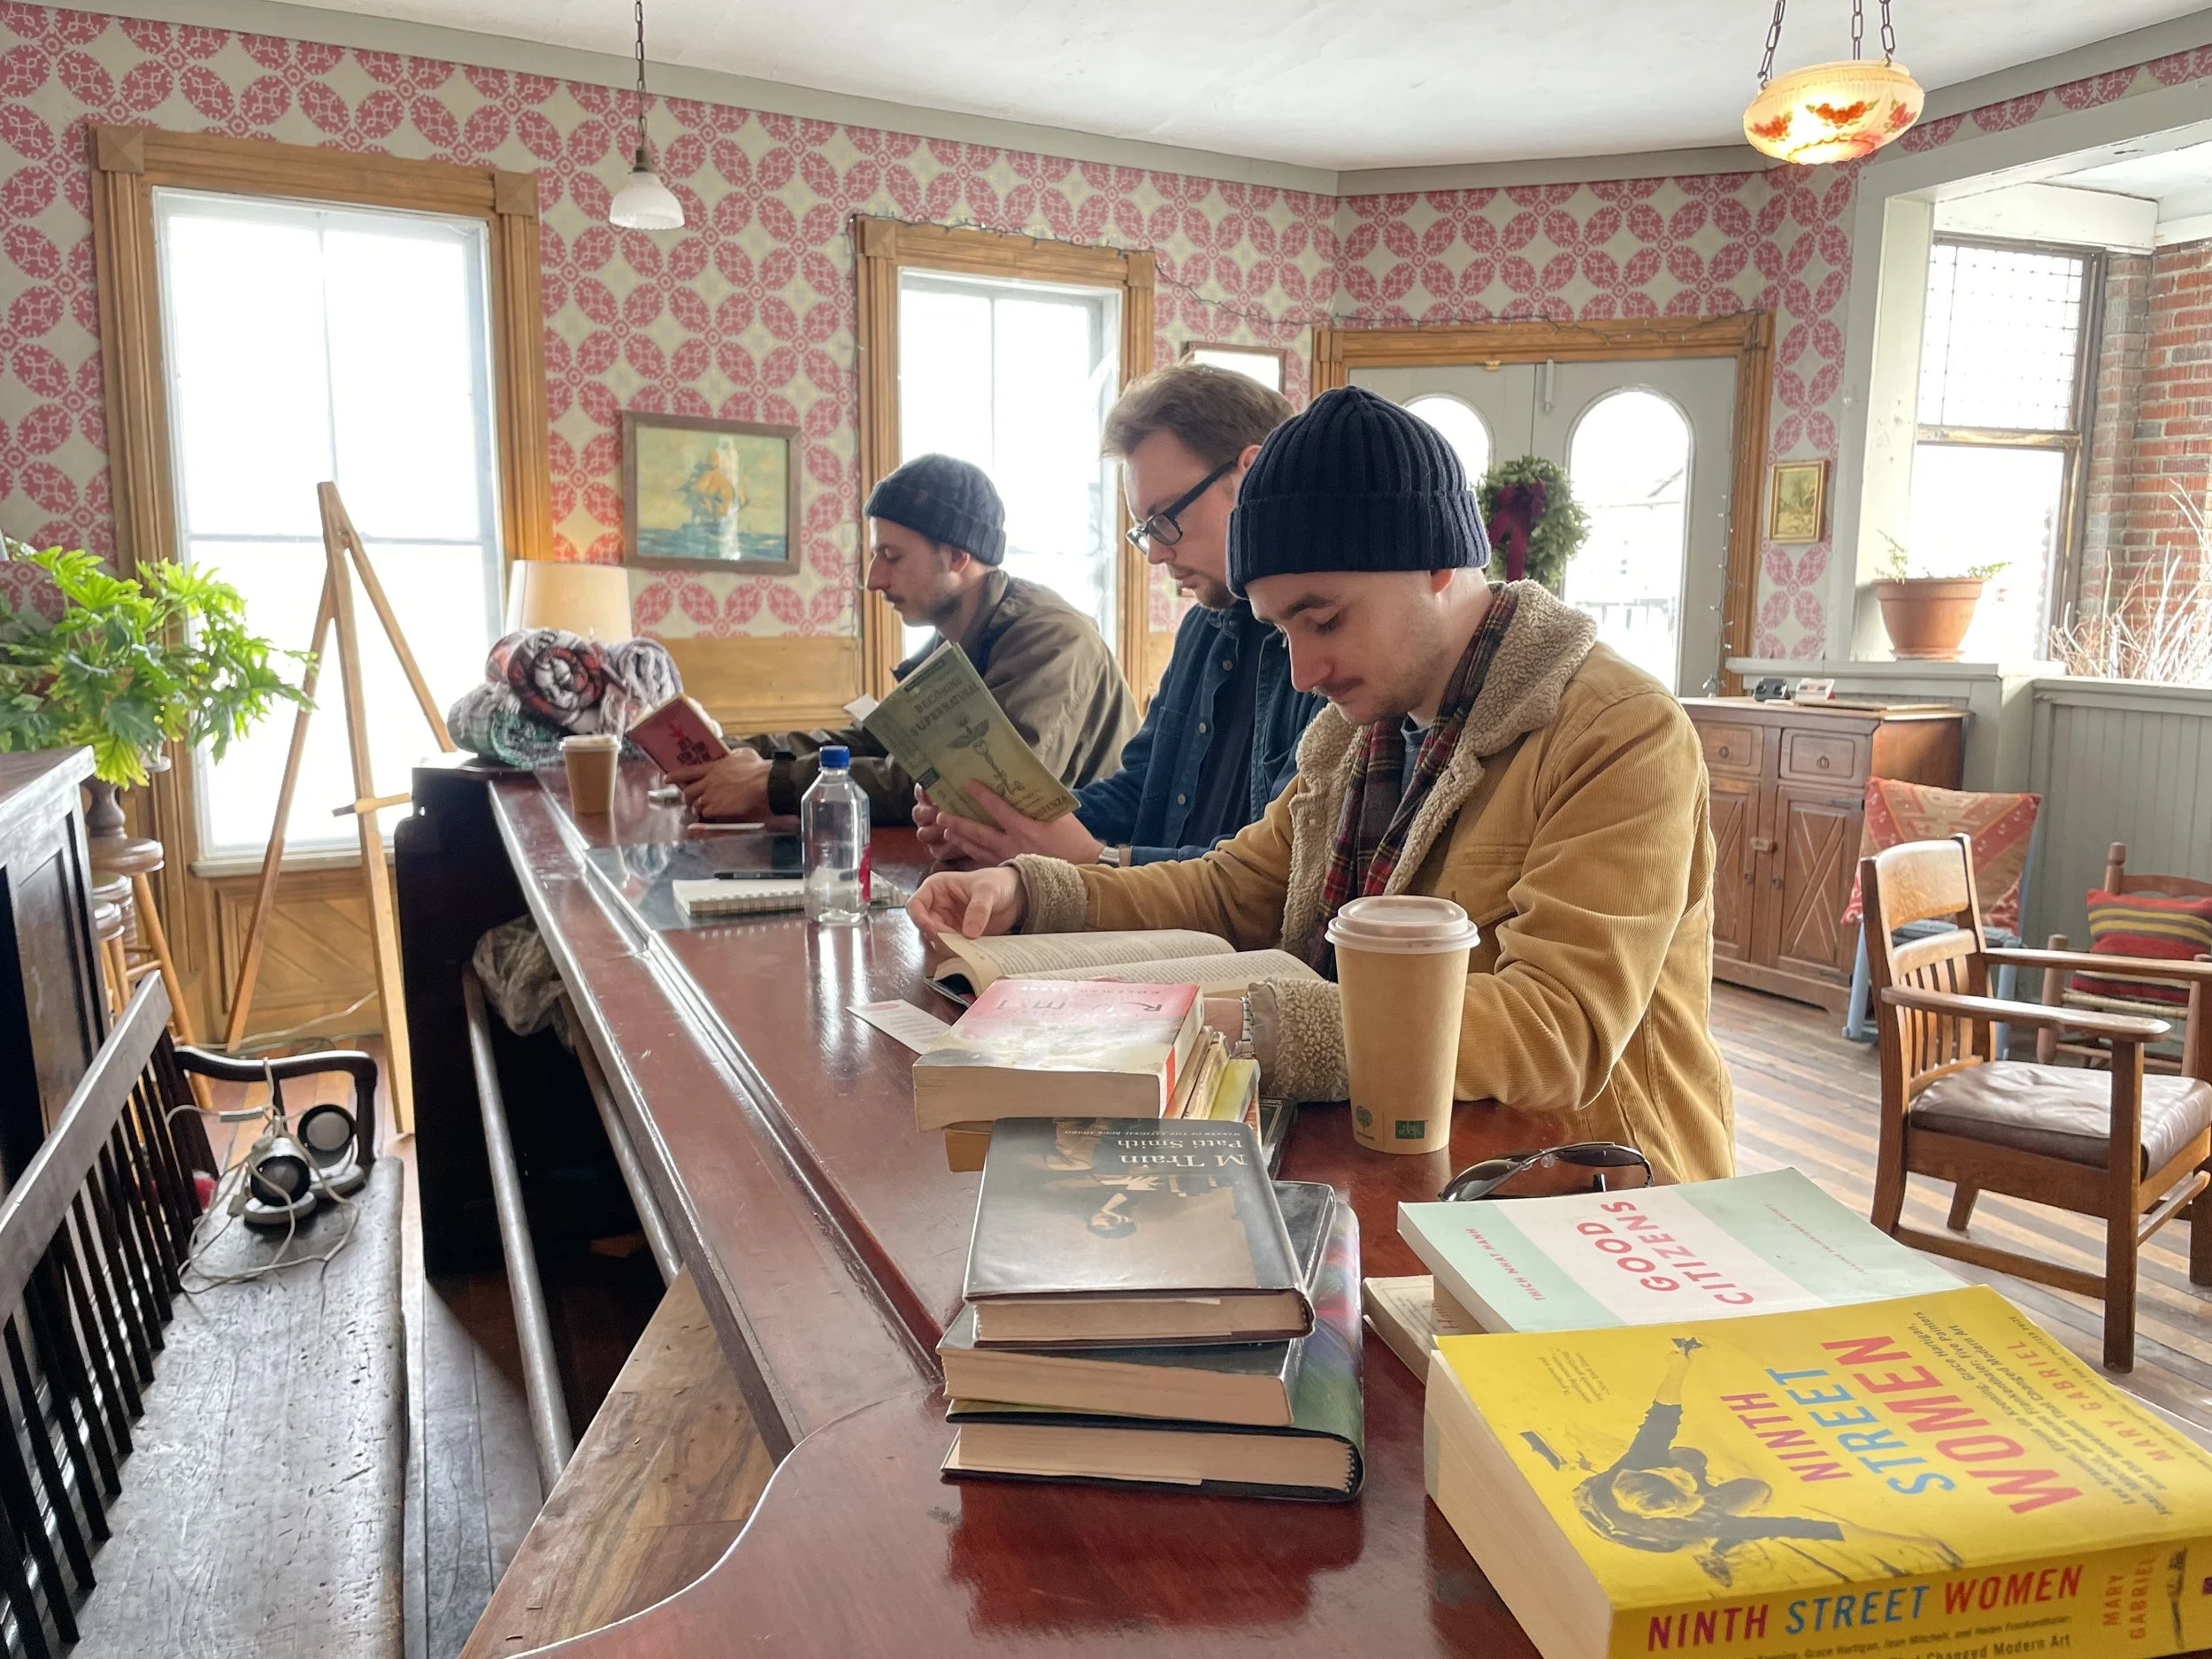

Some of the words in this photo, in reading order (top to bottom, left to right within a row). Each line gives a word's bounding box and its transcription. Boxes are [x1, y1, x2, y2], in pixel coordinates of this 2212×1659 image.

[910, 681, 980, 737] SUPERNATURAL
[914, 676, 964, 713] BECOMING
[1118, 1140, 1183, 1148] Smith
[1119, 1154, 1205, 1168] Train
[1193, 1140, 1244, 1148] Patti
[1214, 1154, 1248, 1166] M
[1465, 1228, 1495, 1250] HANH
[1600, 1201, 1754, 1304] CITIZENS
[1490, 1253, 1518, 1275] NHAT
[1577, 1222, 1680, 1292] GOOD
[1514, 1277, 1547, 1301] THICH
[1908, 1323, 1948, 1357] Hartigan,
[1913, 1311, 1952, 1342] Painters
[1947, 1325, 1968, 1336] Art
[1948, 1342, 1972, 1359] Five
[1964, 1337, 2003, 1366] Modern
[1945, 1359, 1976, 1381] Grace
[1970, 1359, 2040, 1415] Frankenthaler:
[1996, 1367, 2045, 1402] Changed
[2007, 1340, 2103, 1411] GABRIEL
[1975, 1382, 2019, 1417] Kooning,
[2039, 1402, 2068, 1418] That
[1719, 1392, 1855, 1482] NINTH
[1765, 1367, 1956, 1495] STREET
[1819, 1335, 2085, 1515] WOMEN
[2100, 1418, 2177, 1462] MARY
[1647, 1603, 1770, 1652] NINTH
[1785, 1585, 1931, 1635] STREET
[1945, 1565, 2084, 1615] WOMEN
[2102, 1574, 2124, 1626] MARY
[2129, 1555, 2158, 1639] GABRIEL
[1926, 1646, 1987, 1659] Changed
[1993, 1639, 2045, 1655] Modern
[2050, 1634, 2071, 1647] Art
